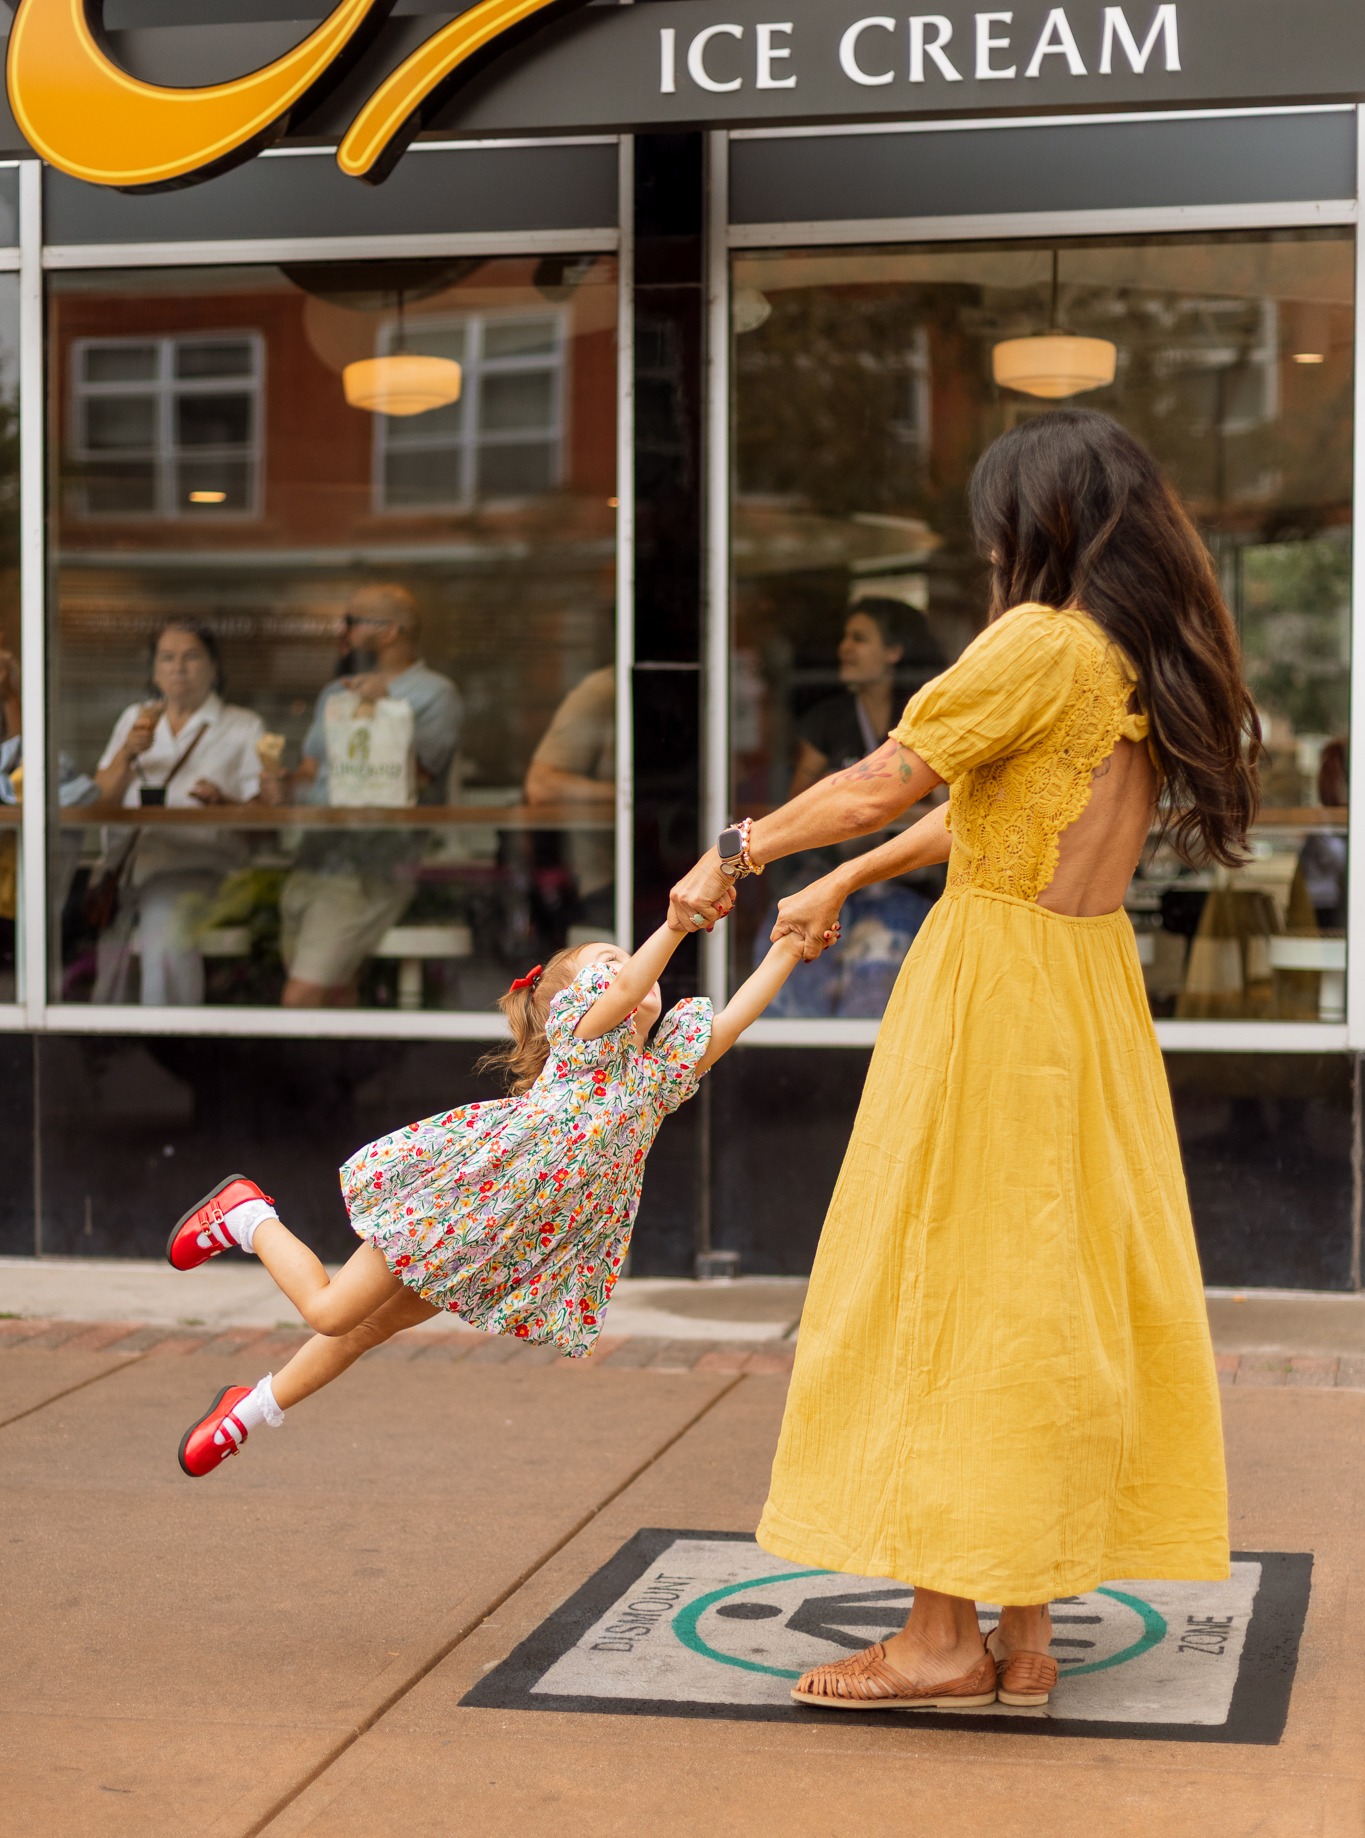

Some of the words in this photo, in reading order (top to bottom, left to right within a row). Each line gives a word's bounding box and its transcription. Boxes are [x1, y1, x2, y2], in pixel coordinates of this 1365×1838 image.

[659, 22, 798, 94] ICE
[838, 3, 1182, 86] CREAM
[589, 1572, 696, 1653] DISMOUNT
[1178, 1614, 1234, 1656] ZONE
